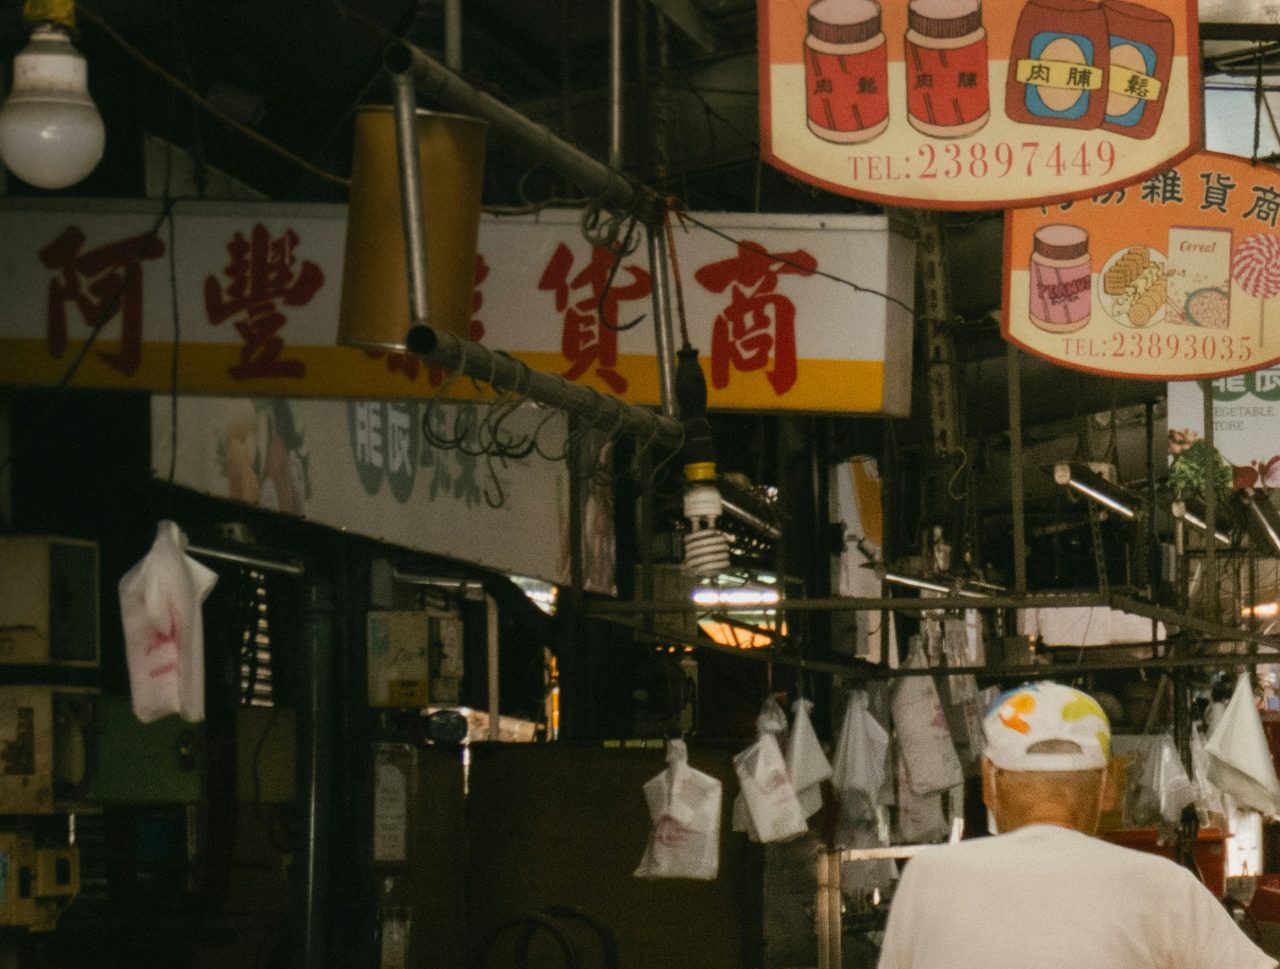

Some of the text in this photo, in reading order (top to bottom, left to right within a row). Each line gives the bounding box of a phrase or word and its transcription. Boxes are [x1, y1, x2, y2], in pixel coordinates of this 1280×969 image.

[1026, 64, 1093, 88] 肉脯
[1180, 241, 1216, 254] Cereal
[37, 223, 818, 396] 阿豐貨商
[1213, 406, 1274, 418] EGETABLE
[1213, 420, 1245, 432] TORE
